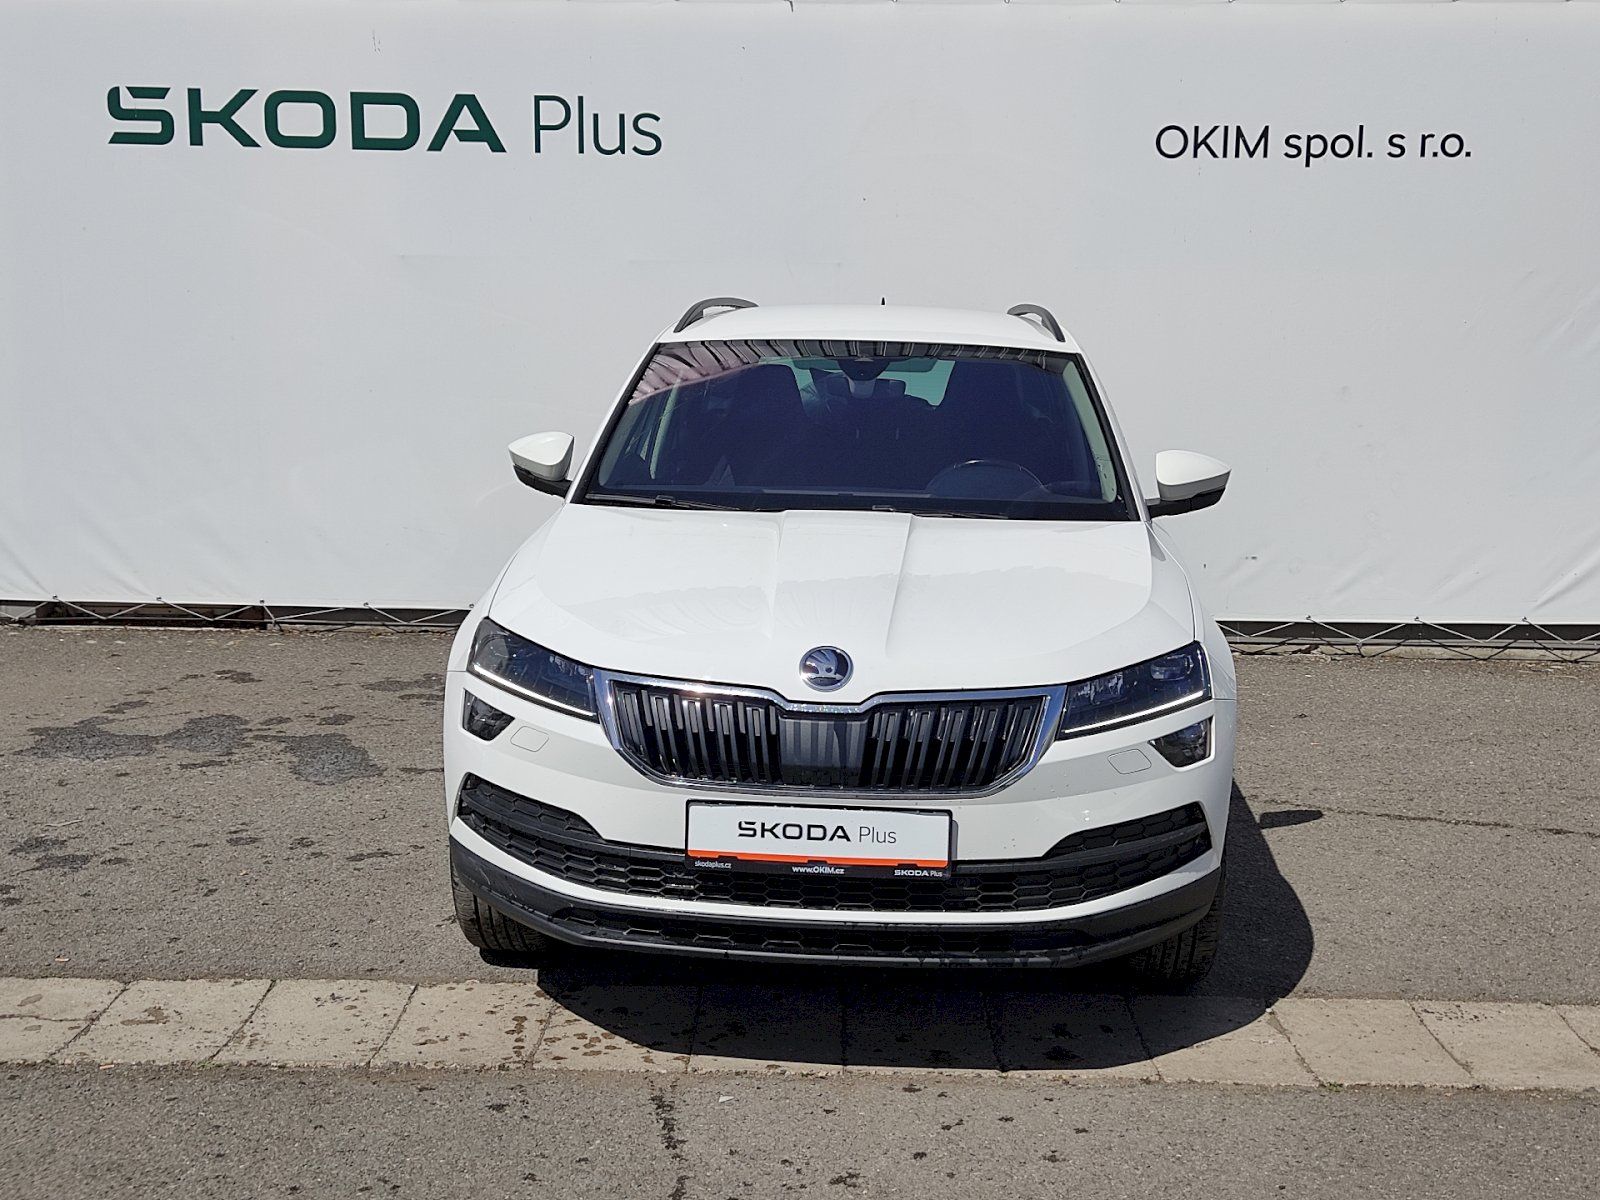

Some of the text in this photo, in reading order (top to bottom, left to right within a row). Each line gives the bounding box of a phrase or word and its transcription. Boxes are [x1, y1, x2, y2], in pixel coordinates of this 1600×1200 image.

[534, 95, 662, 156] Plus
[1156, 125, 1471, 167] OKIM spol. s r.o.
[858, 826, 897, 844] Plus
[791, 865, 845, 875] www.OKIM.cz
[930, 870, 944, 878] Plus
